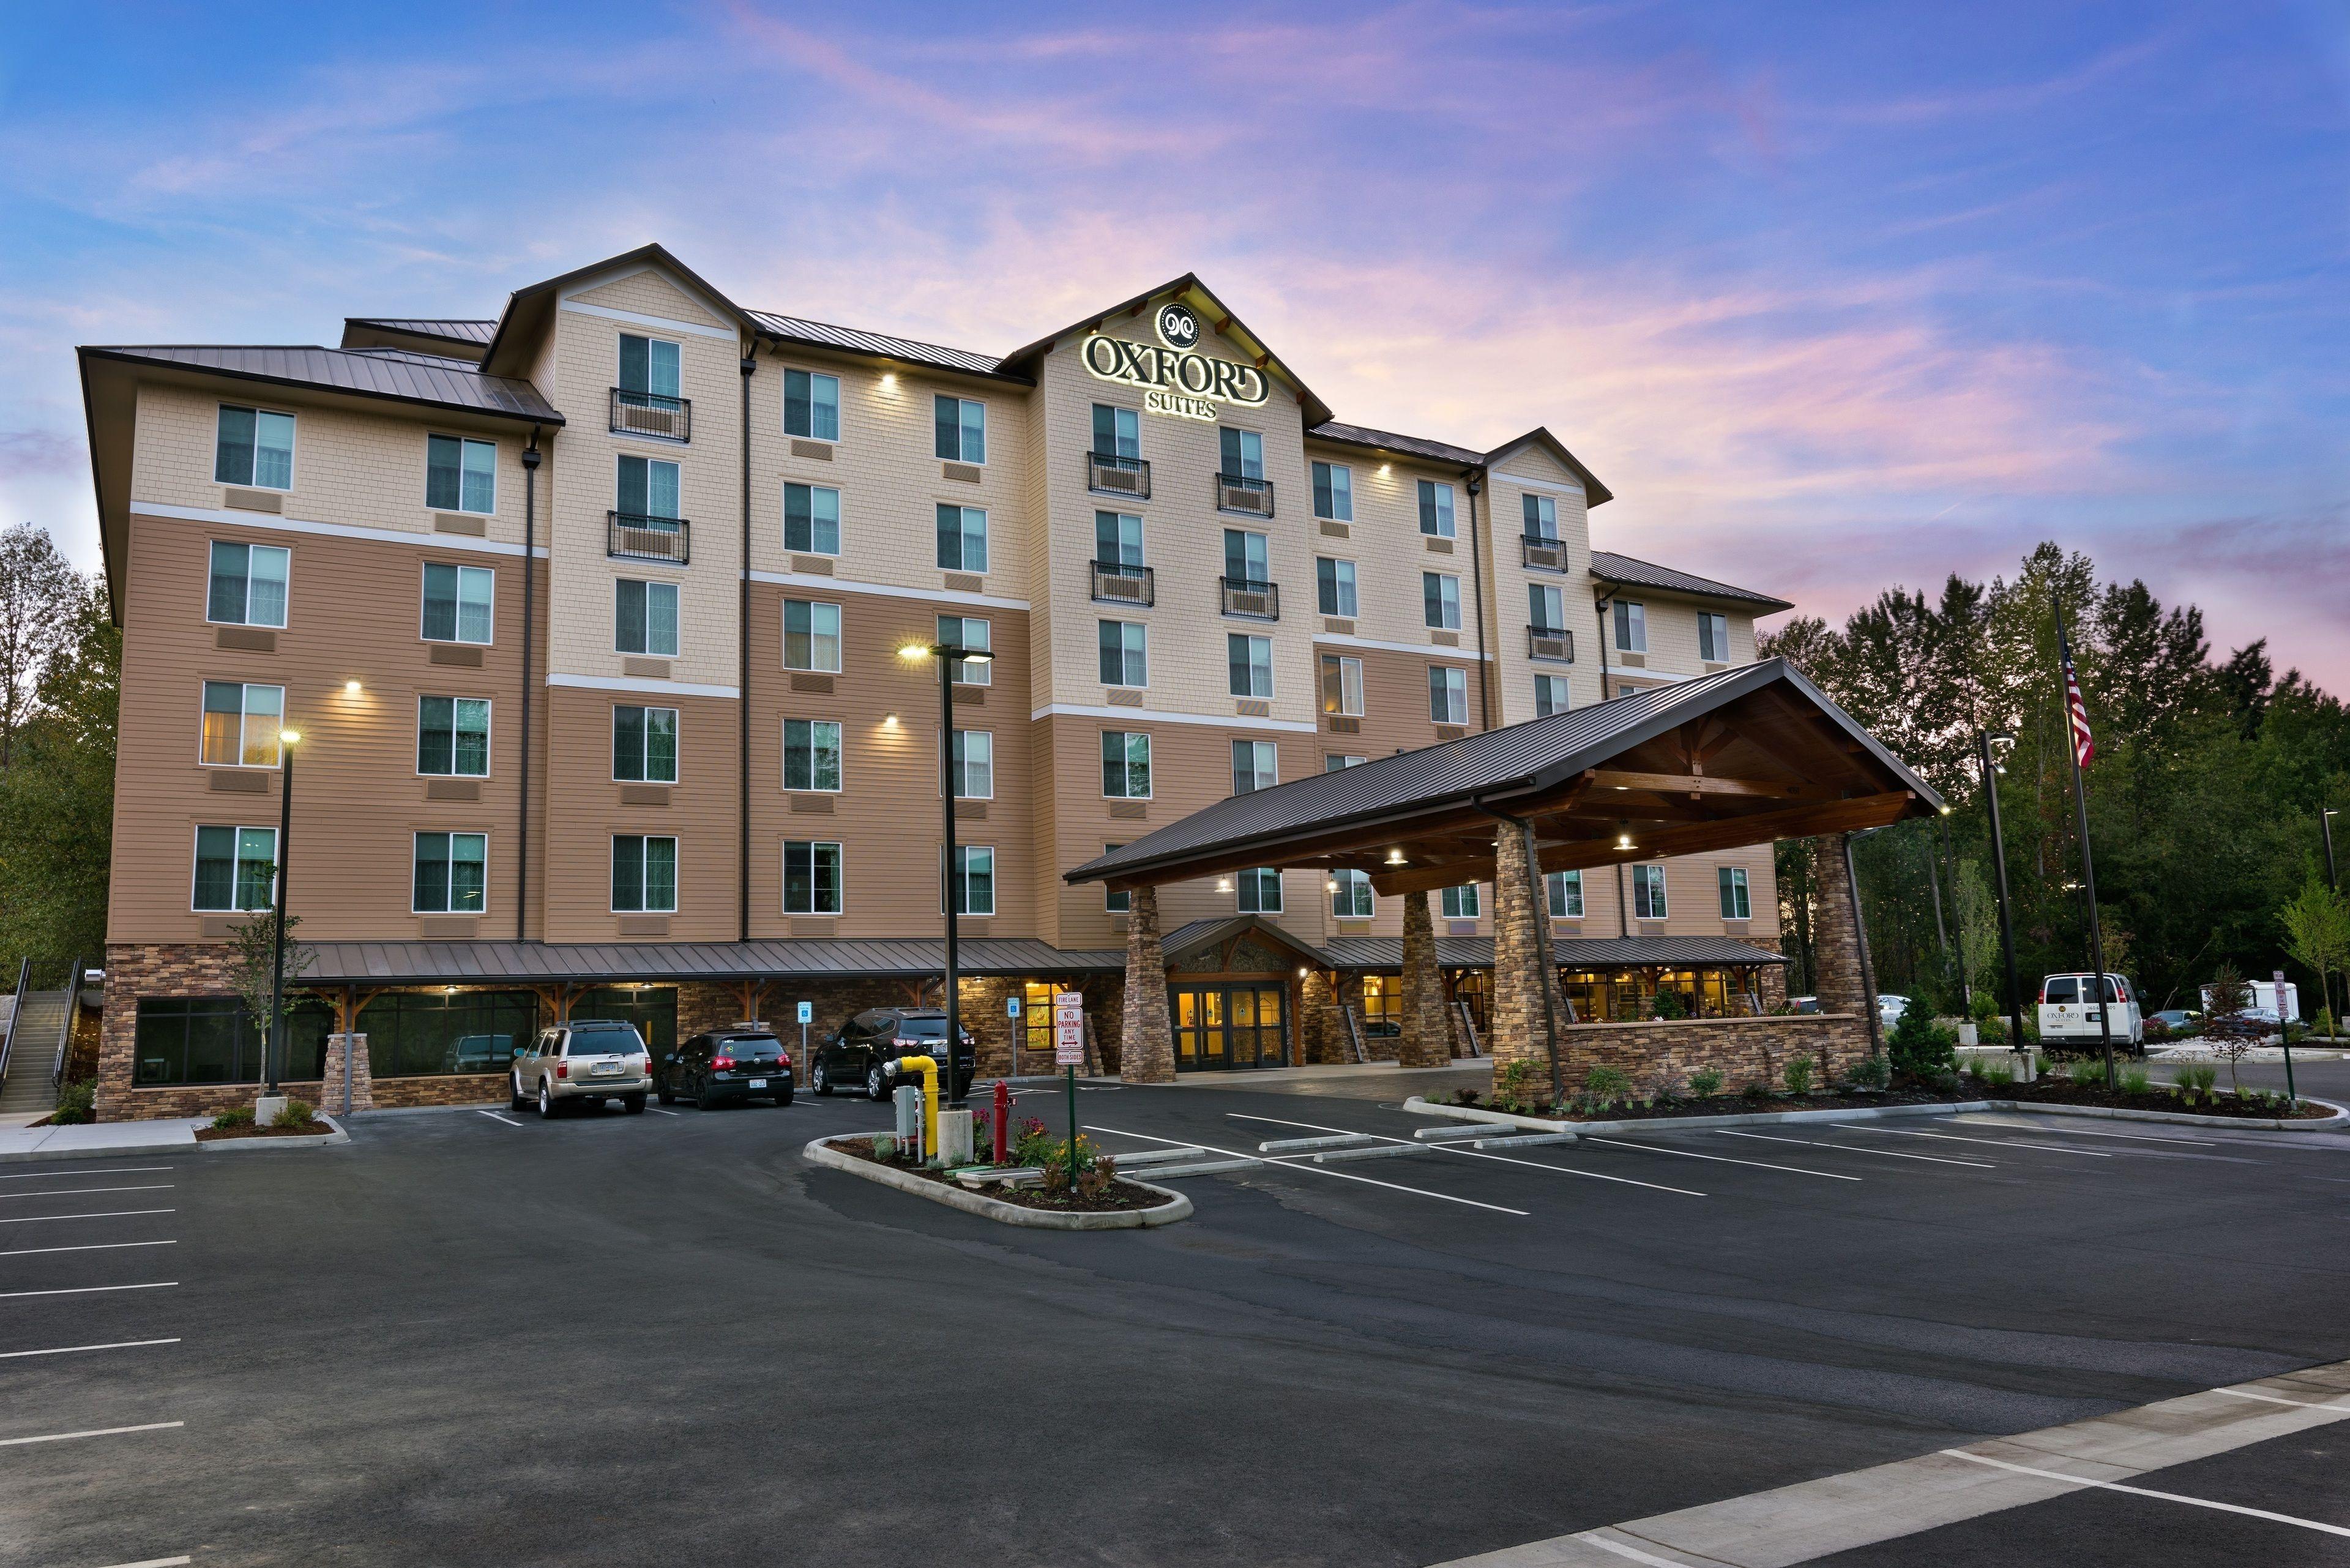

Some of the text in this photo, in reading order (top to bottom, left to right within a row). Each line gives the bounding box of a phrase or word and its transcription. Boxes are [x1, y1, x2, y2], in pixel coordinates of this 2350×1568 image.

[1086, 336, 1269, 403] OXFORD
[1148, 391, 1217, 419] SUITES
[1064, 1011, 1074, 1020] NO
